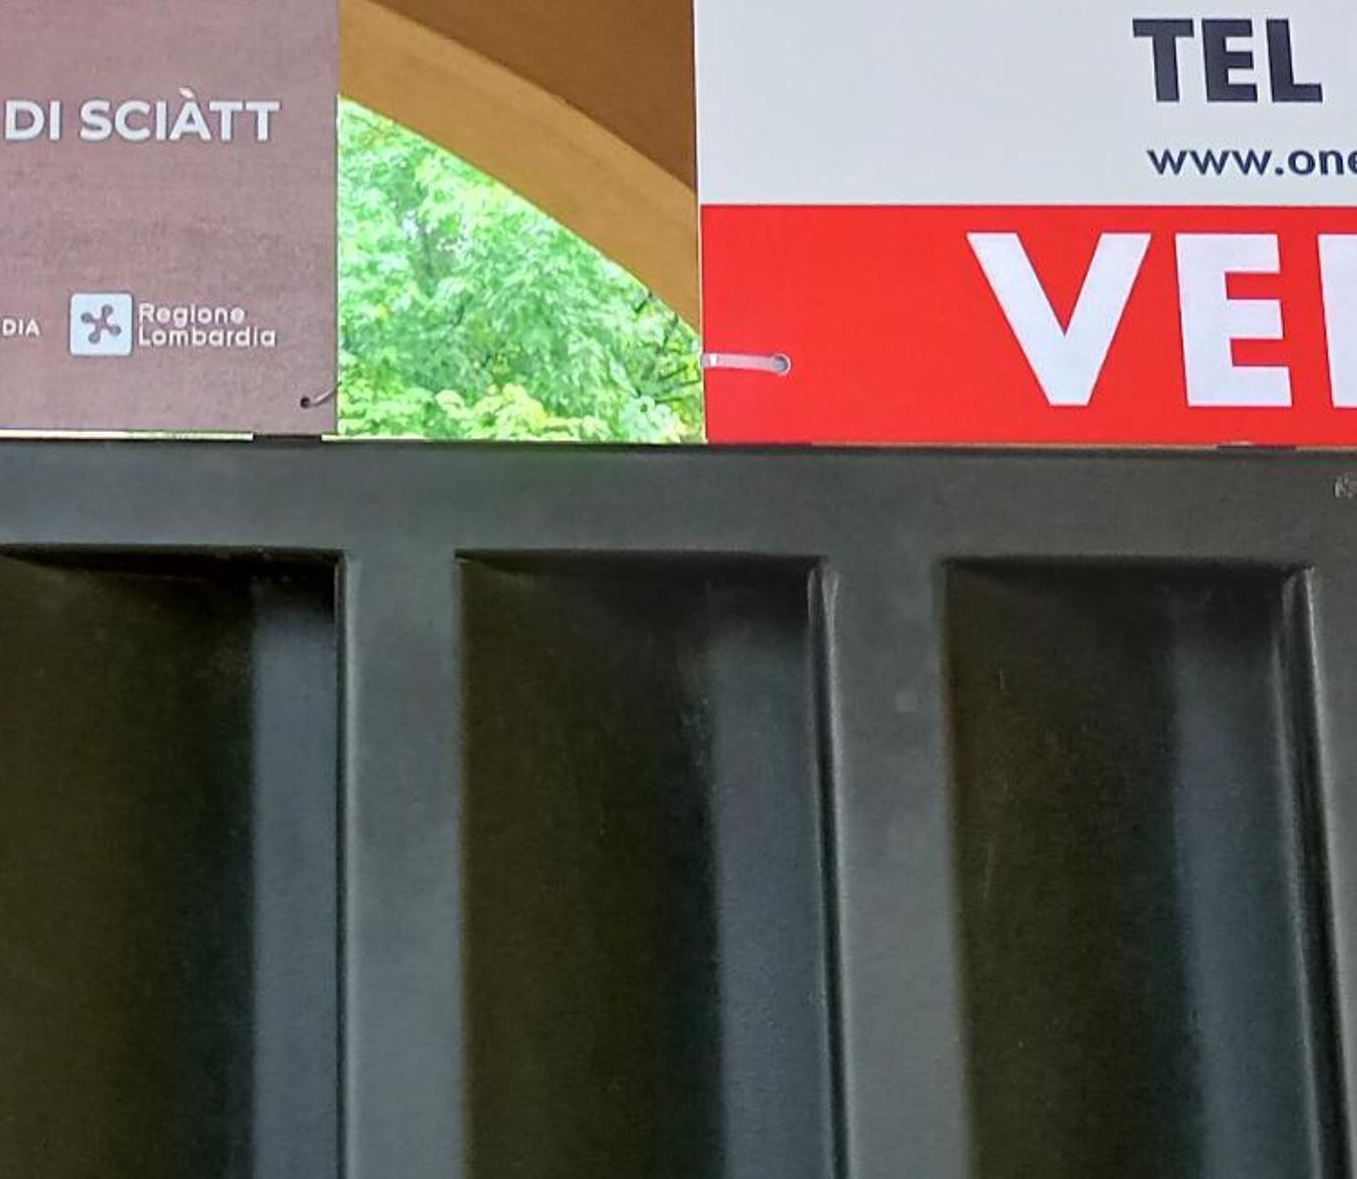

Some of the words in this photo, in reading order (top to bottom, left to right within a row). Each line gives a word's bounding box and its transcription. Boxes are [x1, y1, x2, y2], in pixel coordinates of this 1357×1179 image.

[1132, 18, 1323, 102] TEL
[5, 99, 60, 141] DI
[79, 86, 281, 142] SCIÀTT
[138, 303, 246, 329] Regione
[138, 325, 277, 348] Lombardia
[966, 232, 1357, 407] VE
